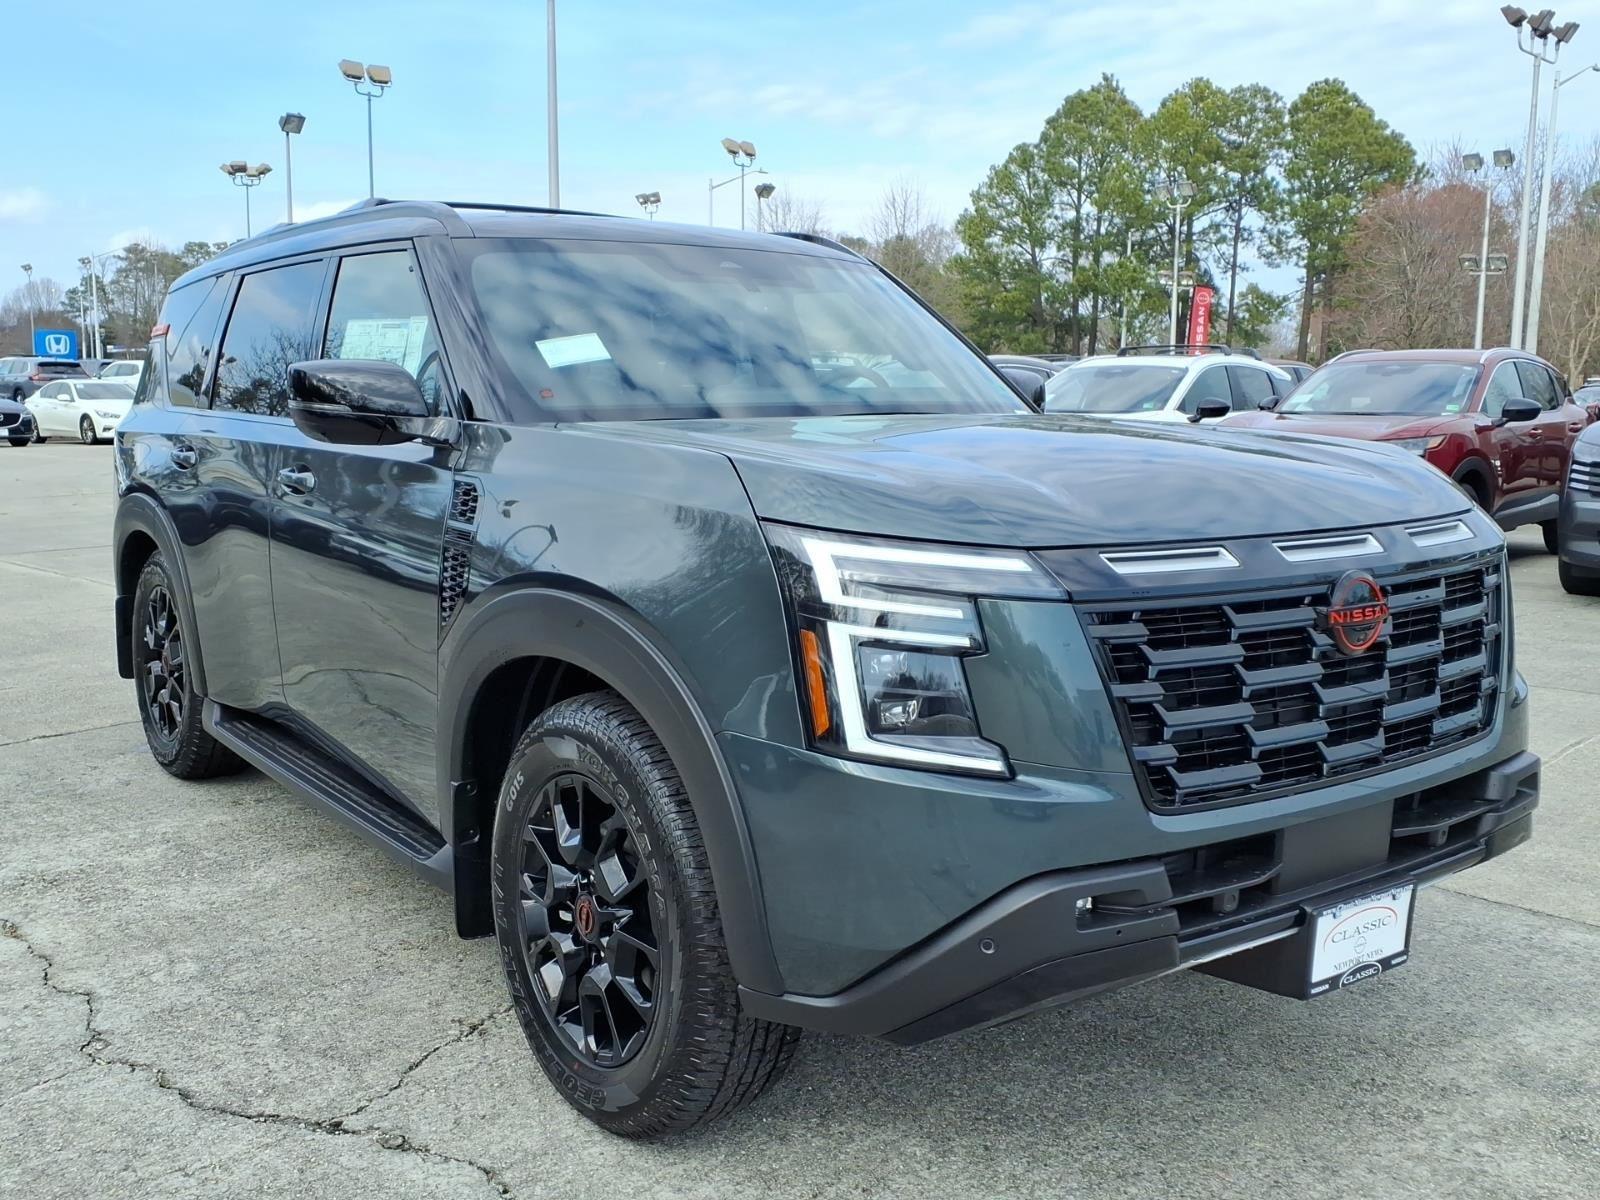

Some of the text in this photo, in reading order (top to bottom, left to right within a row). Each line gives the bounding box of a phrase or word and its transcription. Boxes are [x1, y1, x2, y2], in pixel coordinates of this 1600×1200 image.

[1330, 604, 1388, 623] NISSAN
[506, 770, 525, 811] G015
[576, 743, 667, 918] YOKOHAMA
[1331, 914, 1391, 944] CLASSIC
[1333, 953, 1366, 972] NEWPORT
[1366, 948, 1384, 960] NEWS
[1343, 966, 1379, 984] CLASSIC
